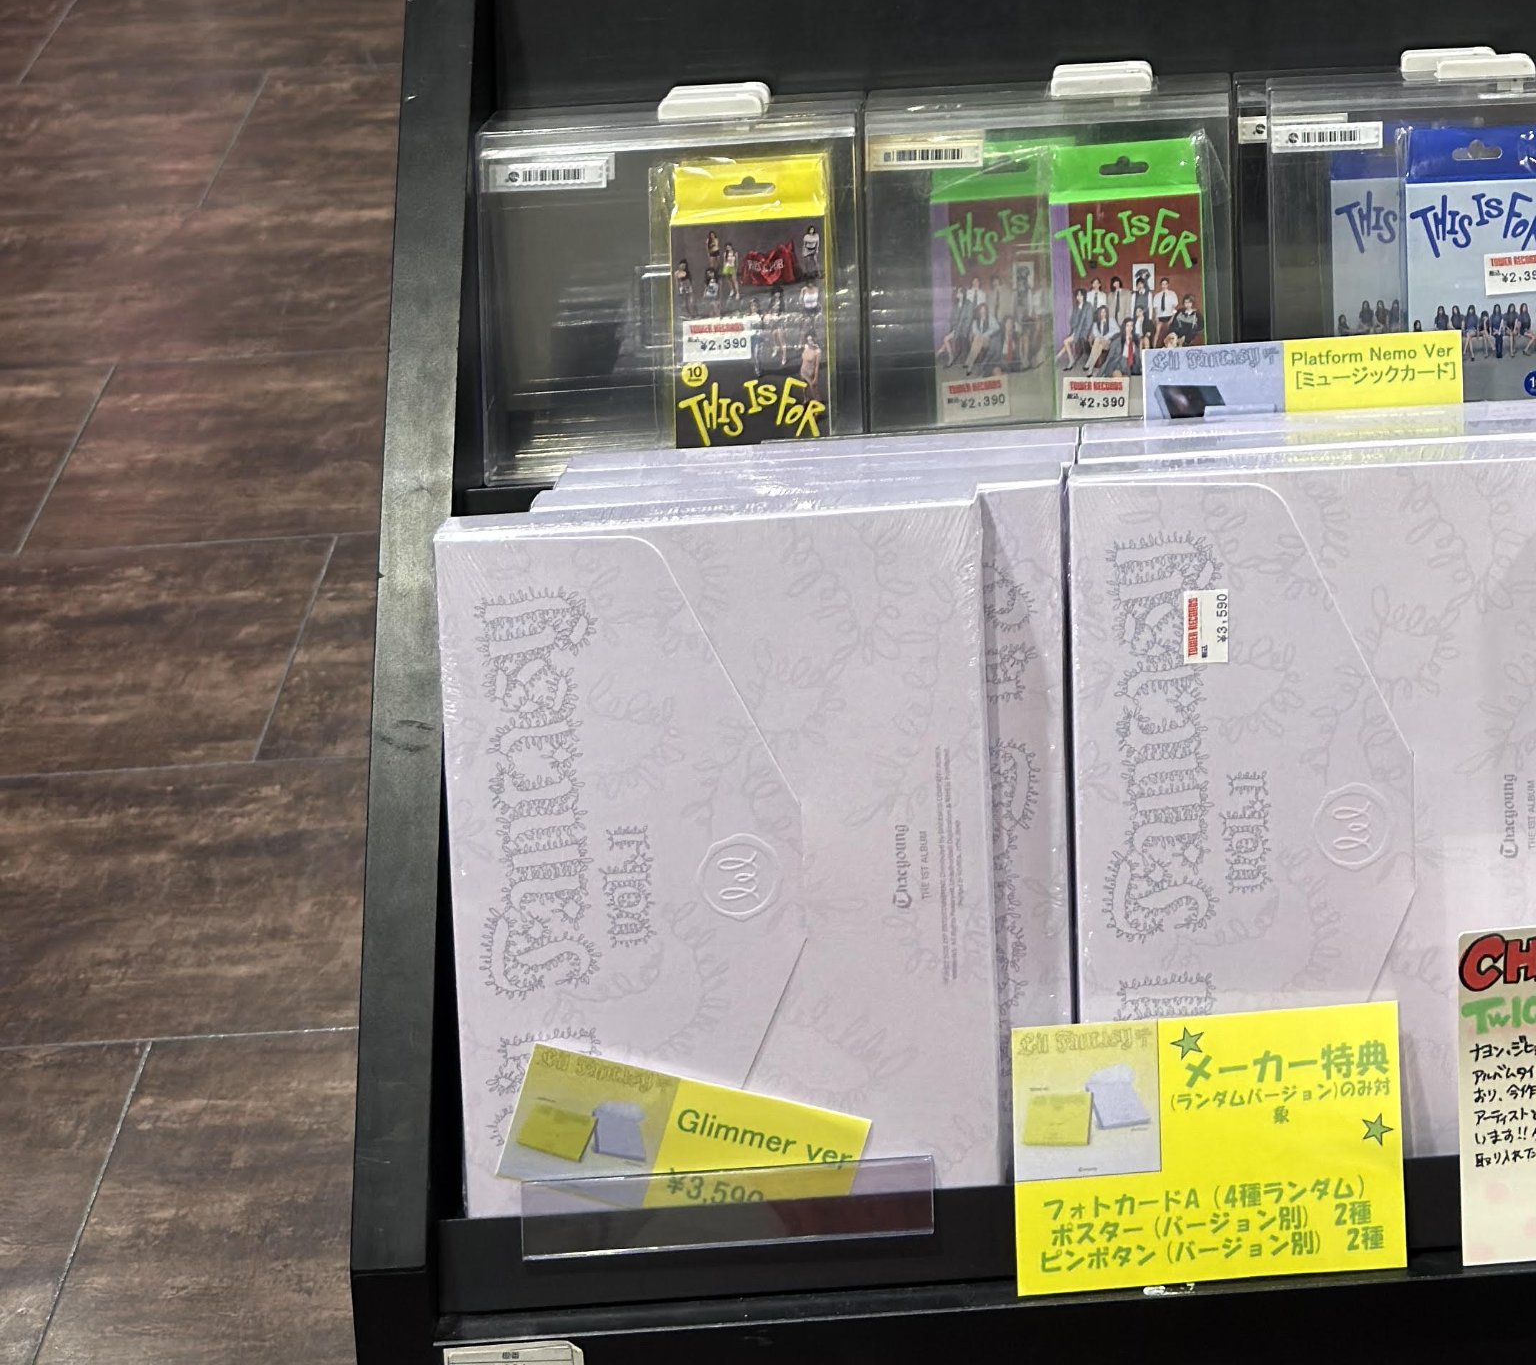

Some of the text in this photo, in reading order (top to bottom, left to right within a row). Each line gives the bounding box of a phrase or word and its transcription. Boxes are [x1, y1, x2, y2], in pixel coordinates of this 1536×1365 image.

[700, 337, 747, 351] ¥2,390
[1291, 344, 1454, 367] Platform Nemo Ver
[688, 366, 702, 378] 10
[961, 393, 1006, 409] ¥2,390
[1186, 1040, 1390, 1087] メーカー特典
[676, 1109, 797, 1156] Glimmer
[1334, 1200, 1372, 1227] 2種
[1347, 1226, 1384, 1252] 2種
